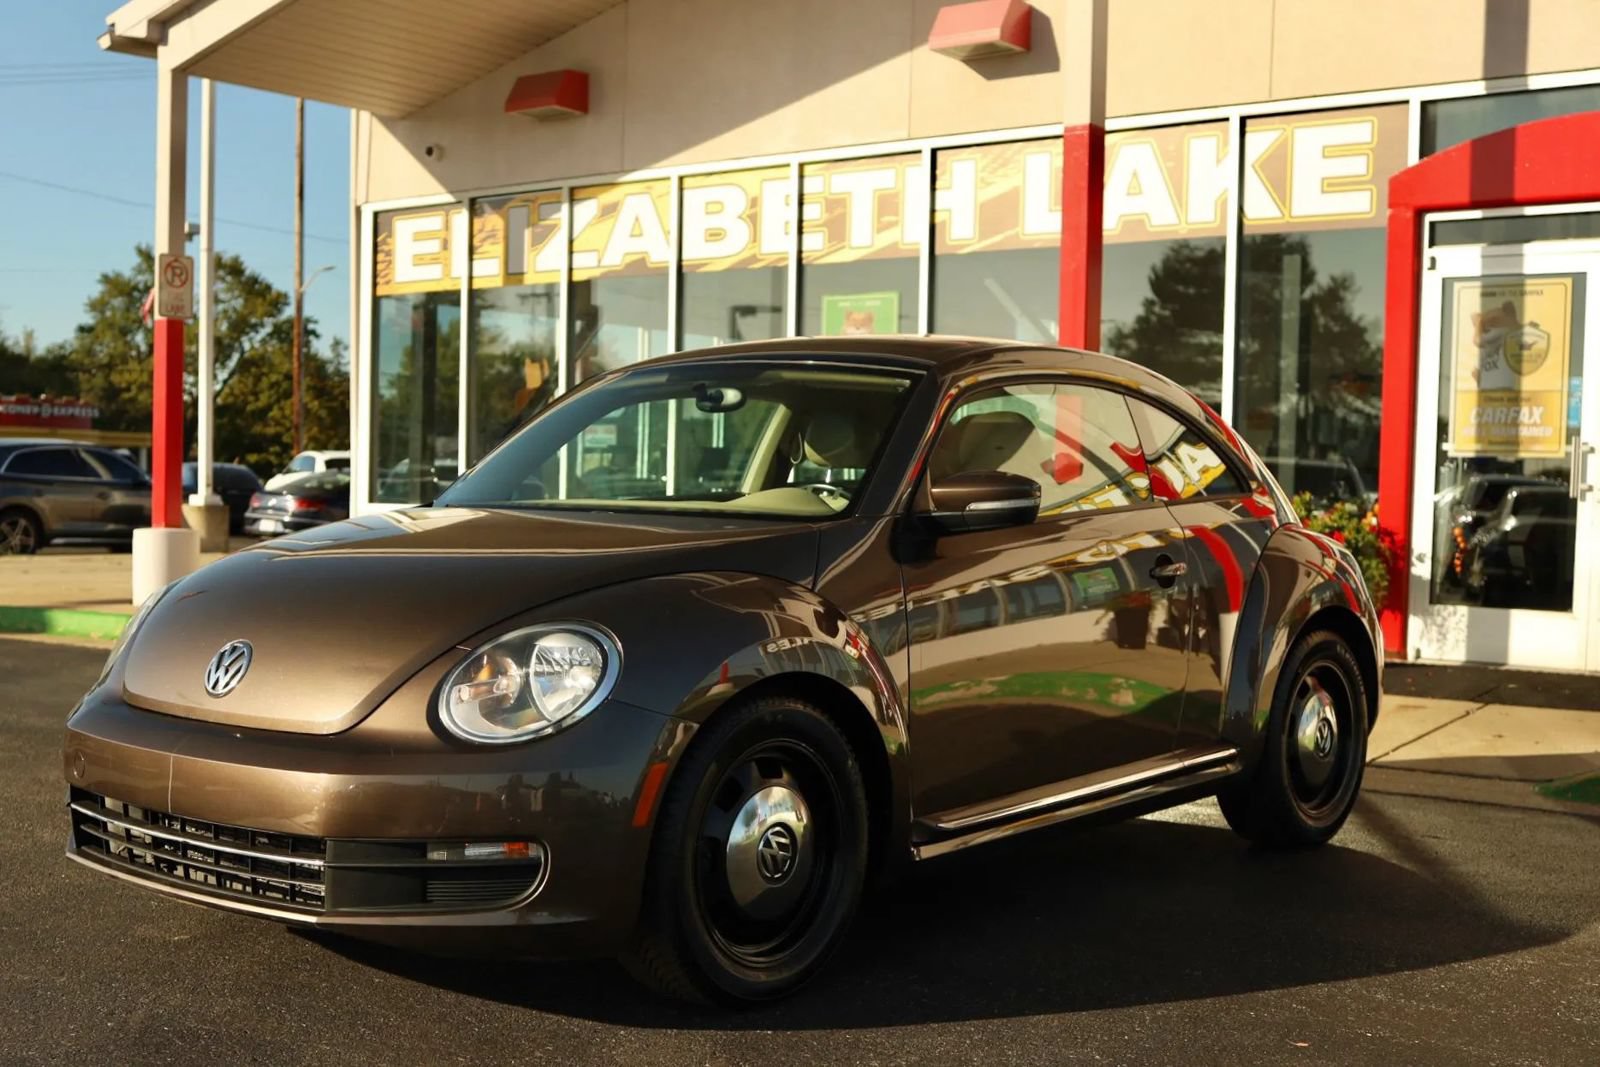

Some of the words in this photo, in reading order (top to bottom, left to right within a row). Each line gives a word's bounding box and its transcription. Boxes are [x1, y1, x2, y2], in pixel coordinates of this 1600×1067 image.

[392, 157, 977, 284] ELIZABETH
[1022, 119, 1376, 236] LAKE
[1470, 406, 1545, 425] CARFAX
